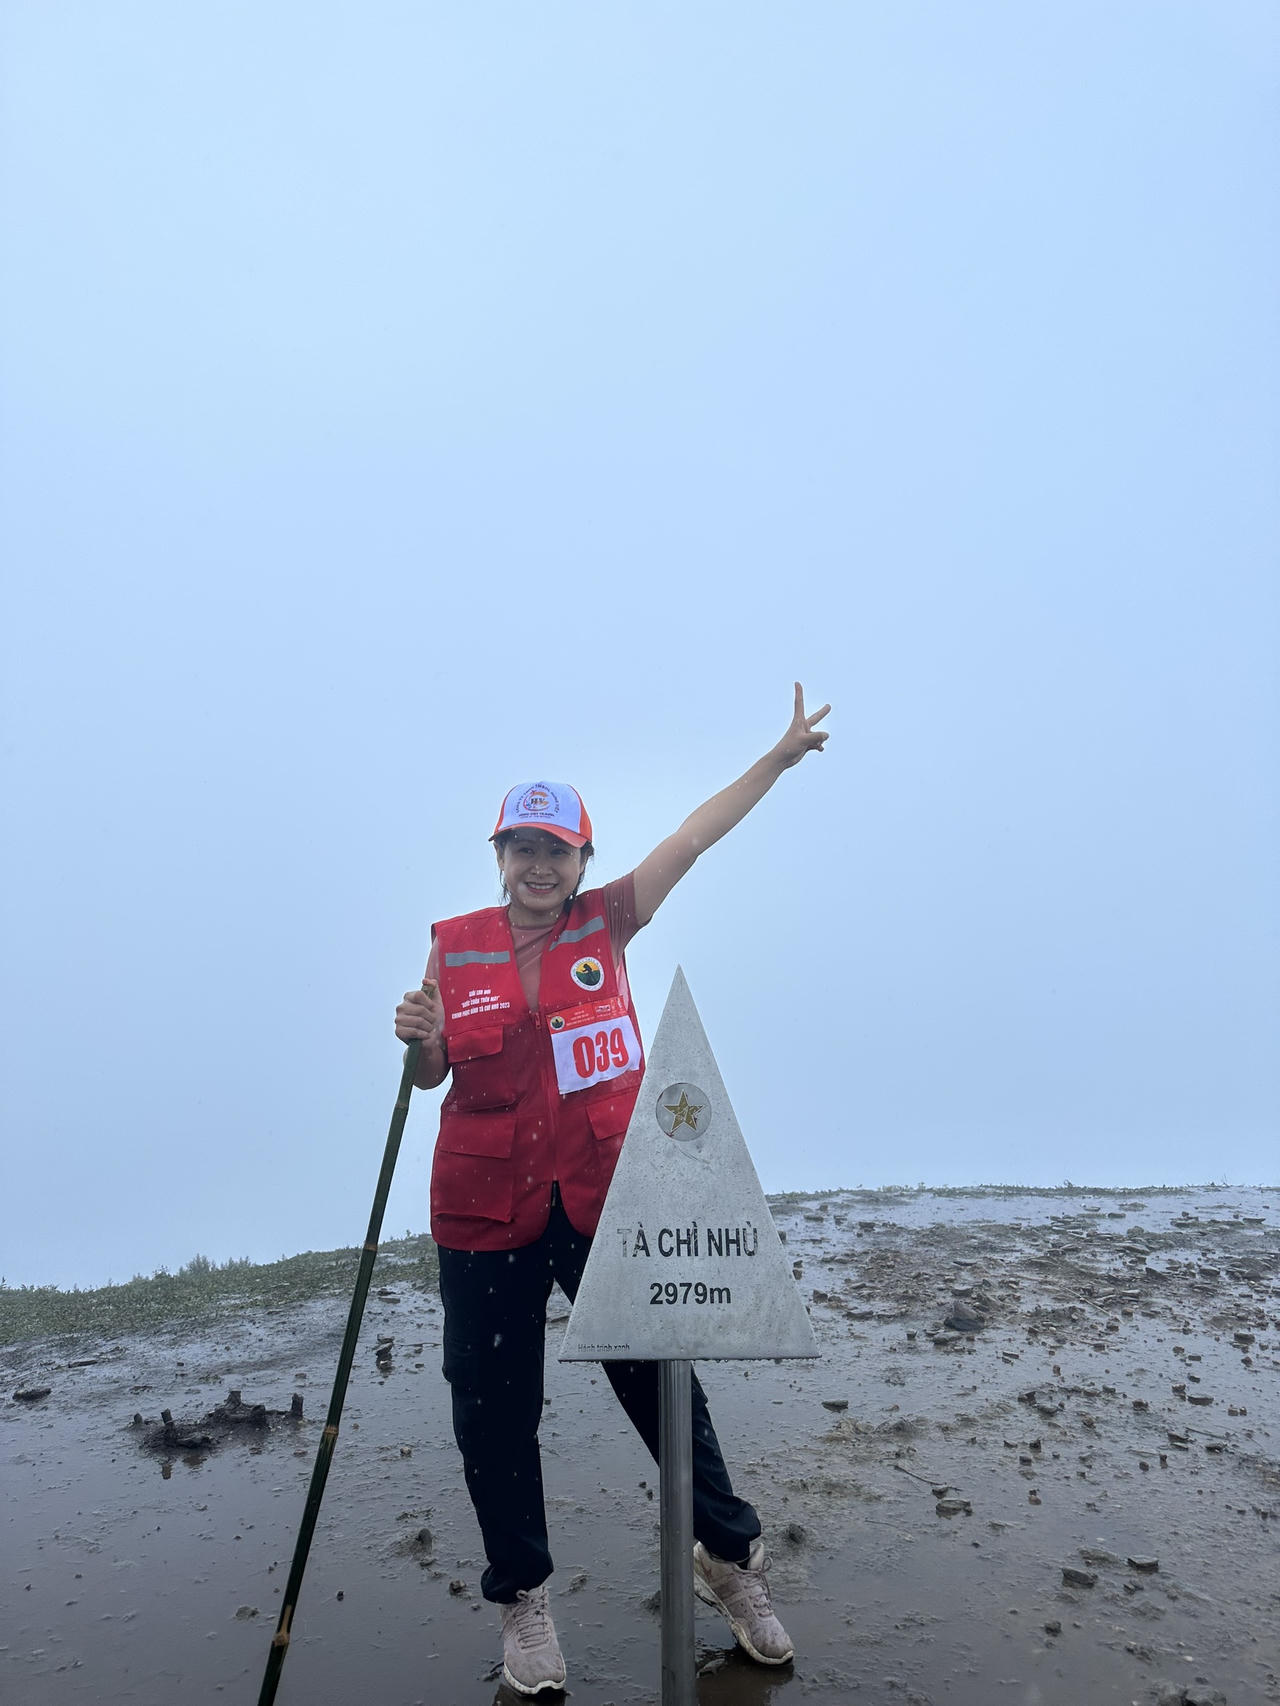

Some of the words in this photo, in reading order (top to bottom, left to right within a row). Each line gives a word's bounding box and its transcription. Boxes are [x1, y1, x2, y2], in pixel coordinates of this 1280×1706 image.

[573, 1028, 629, 1078] 039
[617, 1221, 650, 1257] TÀ
[658, 1221, 699, 1257] CHÌ
[707, 1221, 758, 1257] NHÙ
[650, 1282, 731, 1304] 2979m
